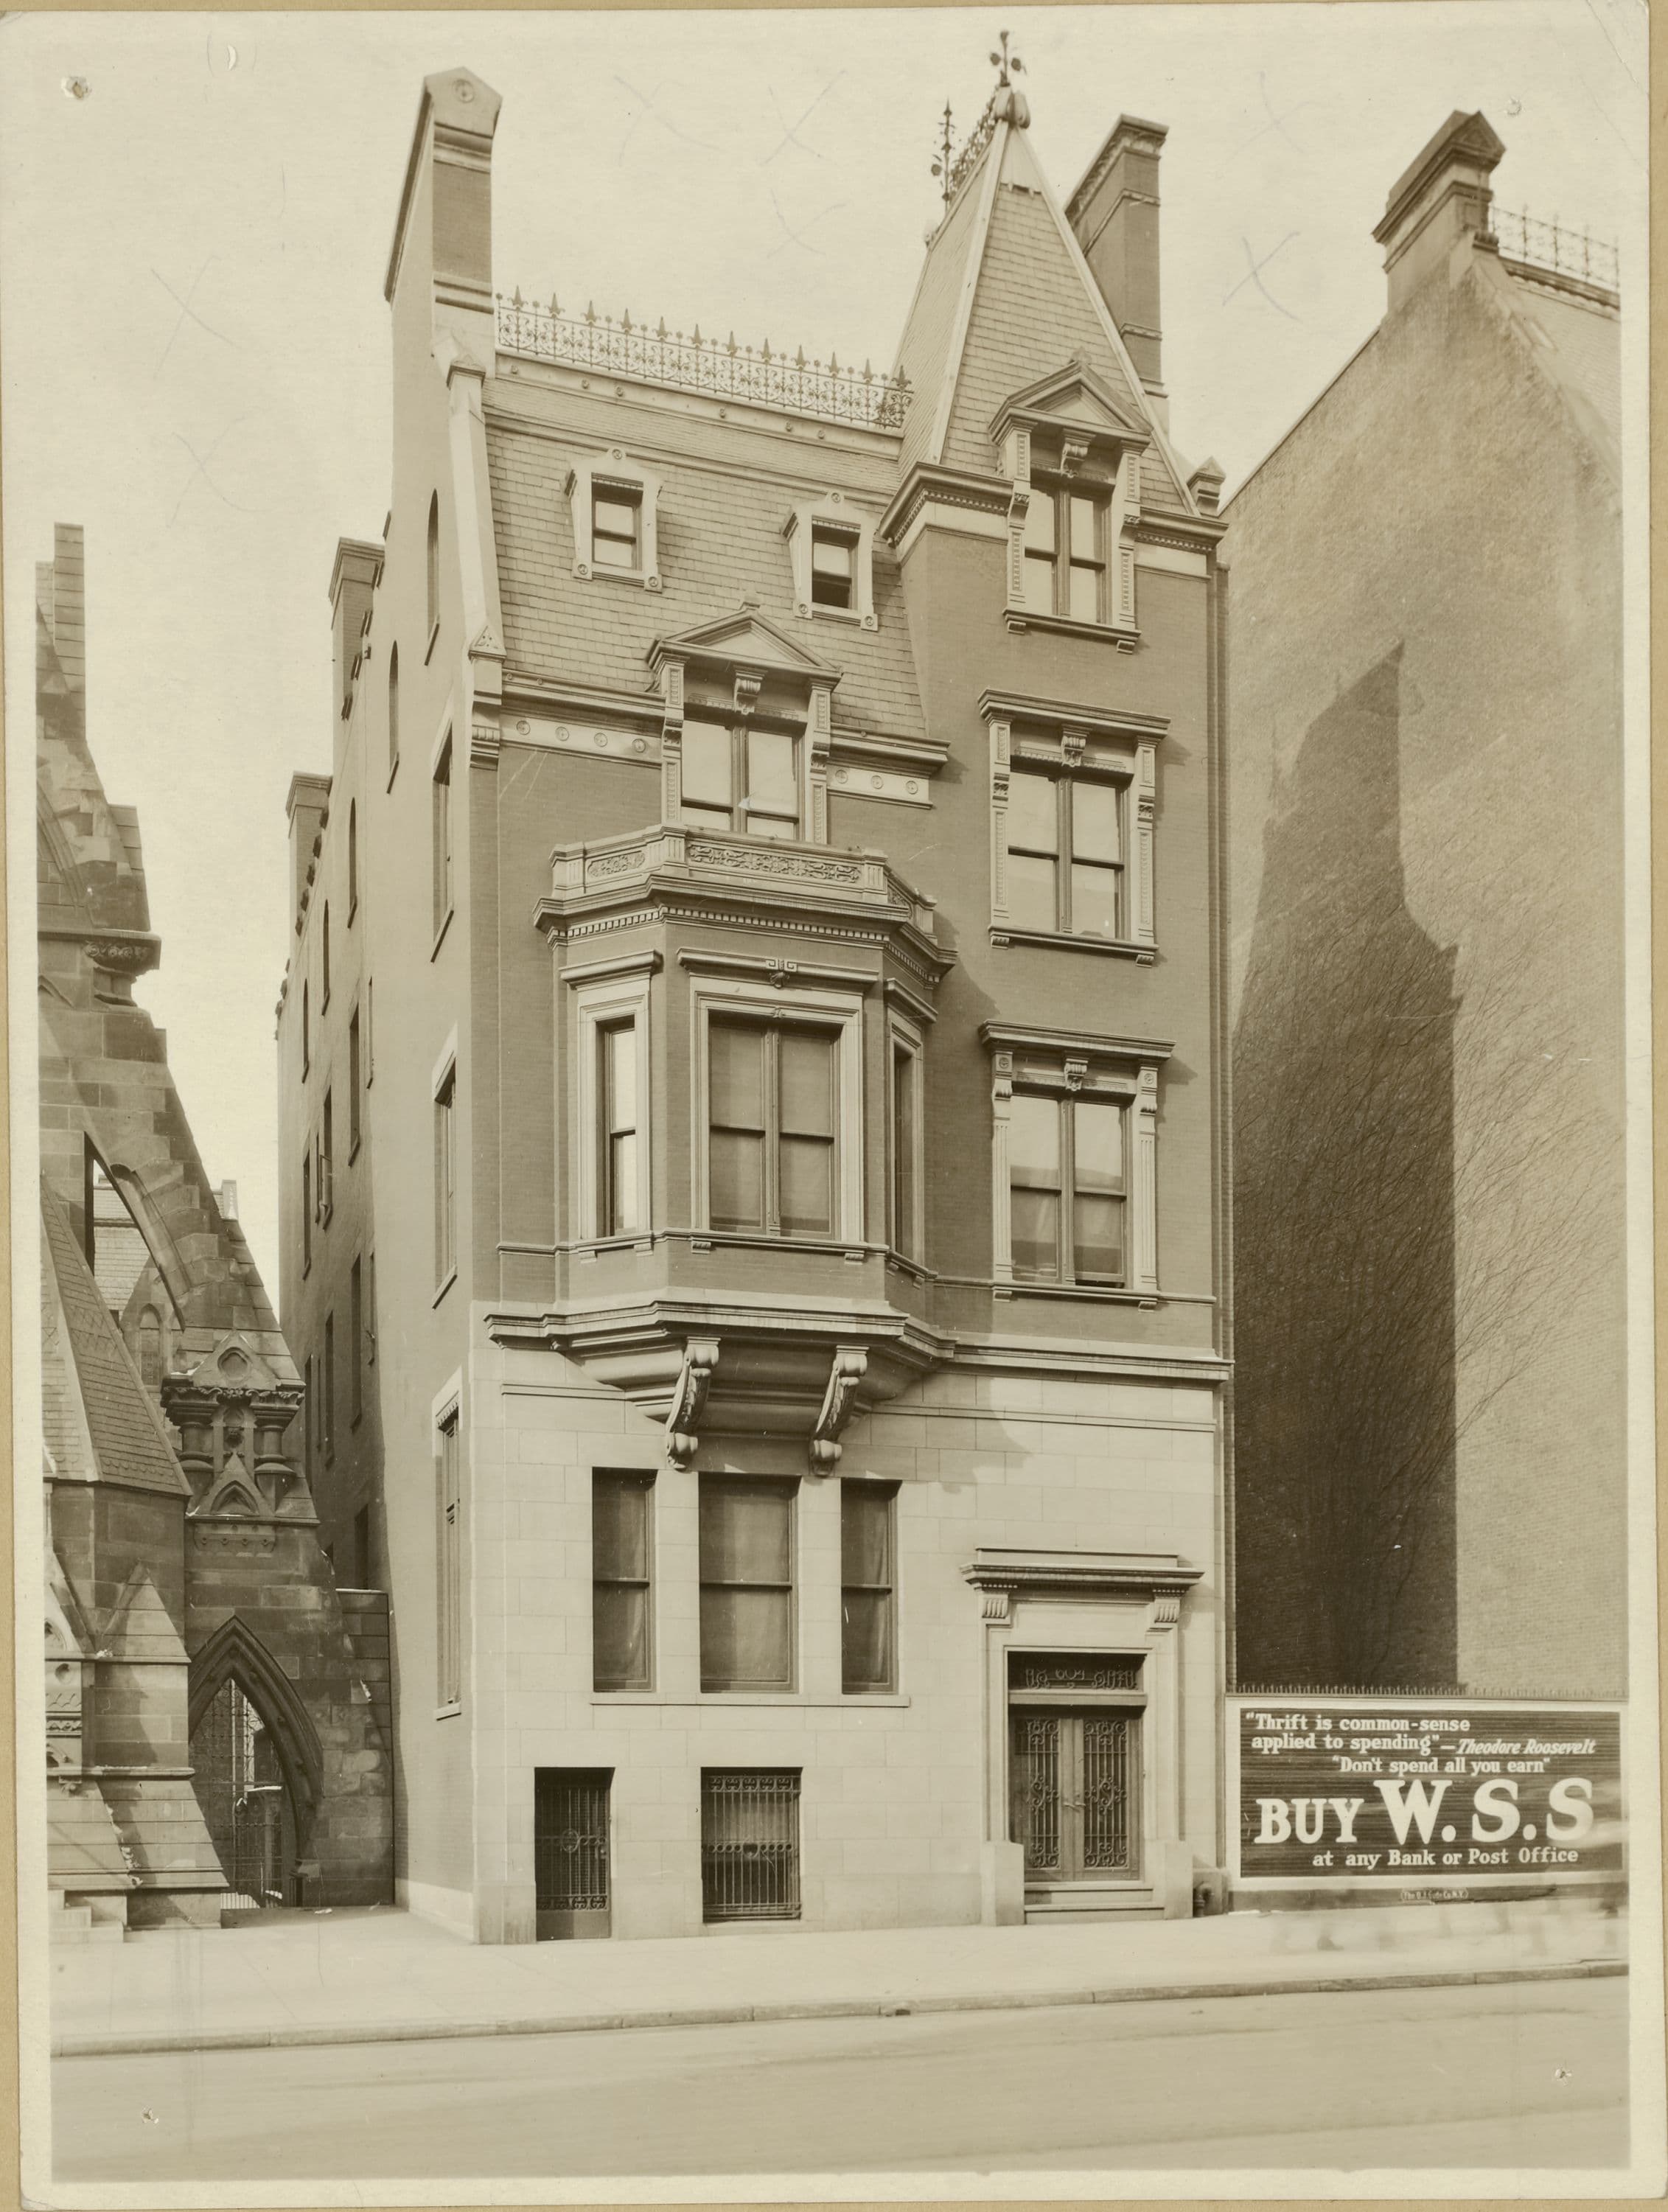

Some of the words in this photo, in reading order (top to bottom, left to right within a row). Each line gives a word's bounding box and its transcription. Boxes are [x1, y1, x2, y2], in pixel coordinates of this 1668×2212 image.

[1316, 1715, 1333, 1731] is
[1339, 1717, 1471, 1732] common-sense
[1252, 1732, 1317, 1755] applied
[1323, 1734, 1344, 1749] to
[1523, 1738, 1597, 1755] Roosevelt
[1389, 1756, 1439, 1778] spend
[1444, 1756, 1467, 1773] all
[1470, 1760, 1501, 1777] you
[1254, 1798, 1365, 1844] BUY
[1312, 1850, 1334, 1866] at
[1345, 1853, 1382, 1870] any
[1387, 1849, 1437, 1866] Bank
[1442, 1852, 1463, 1866] or
[1468, 1847, 1510, 1865] Post
[1518, 1846, 1579, 1864] Office
